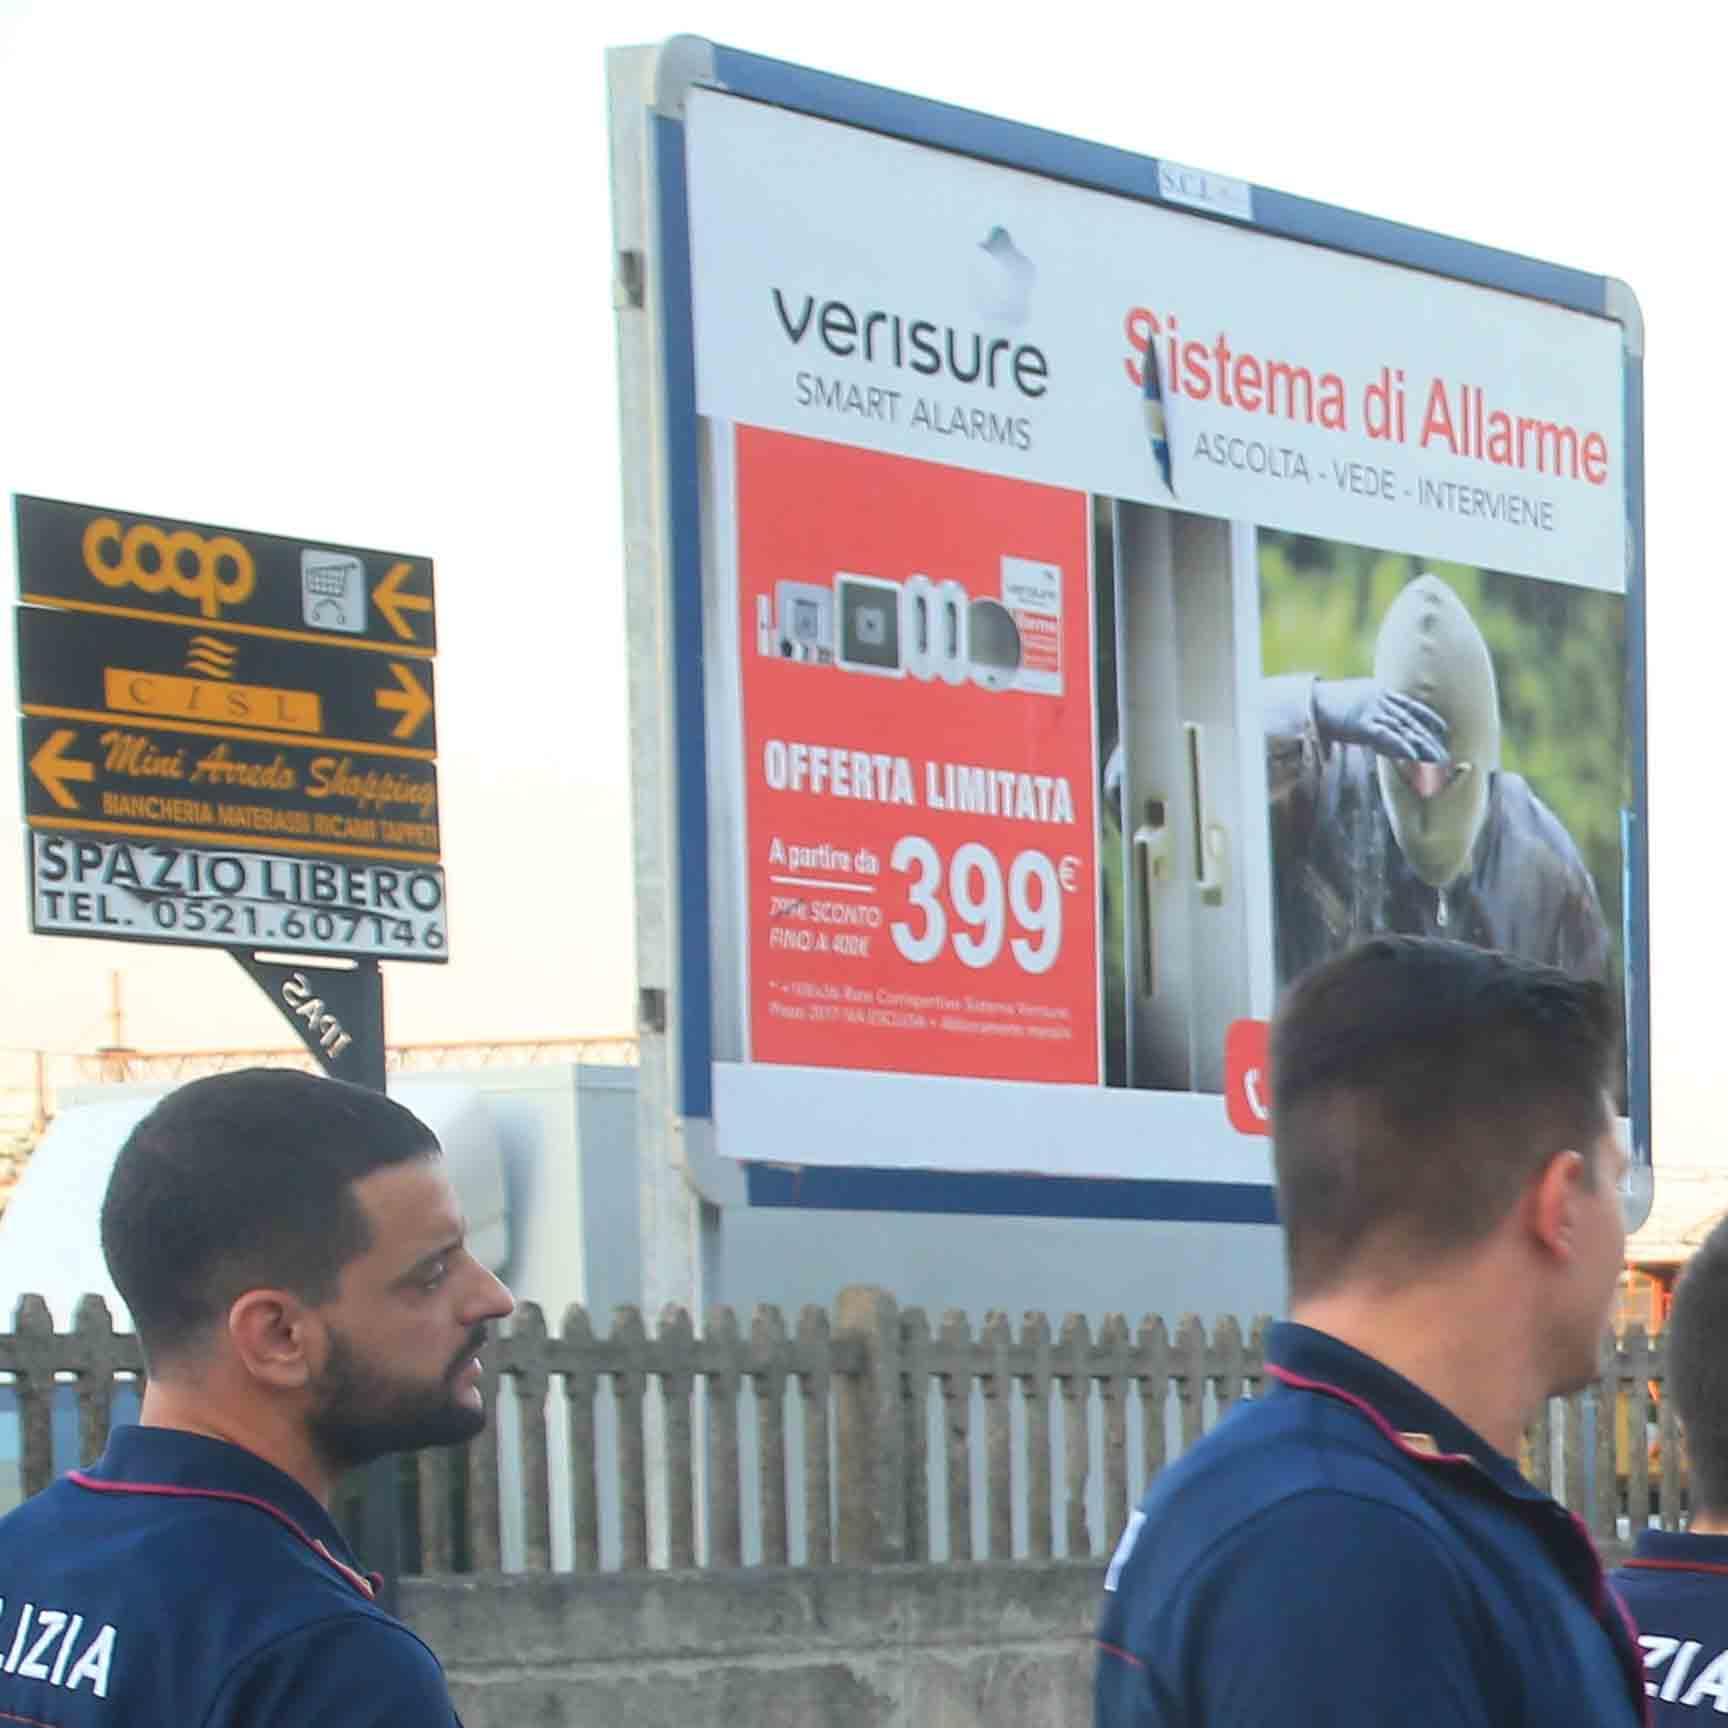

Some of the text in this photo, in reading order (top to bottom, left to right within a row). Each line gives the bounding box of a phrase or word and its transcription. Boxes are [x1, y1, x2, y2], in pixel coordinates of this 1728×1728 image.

[772, 287, 1048, 398] verisure
[796, 372, 1032, 451] SMART ALARMS
[1124, 307, 1608, 486] Sistema di Allarme
[1193, 432, 1311, 483] ASCOLTA
[1333, 461, 1395, 500] VEDE
[1418, 475, 1554, 531] INTERVIENE
[82, 518, 255, 619] coop
[127, 676, 298, 725] CISL
[101, 729, 435, 818] Mini Arredo Shopping
[764, 740, 1075, 824] OFFERTA LIMITATA
[39, 838, 443, 911] SPAZIO LIBERO
[769, 836, 880, 876] A partire da
[40, 890, 444, 950] TEL. 0521.607146
[811, 900, 882, 928] SCONTO
[0, 1597, 118, 1698] IZIA
